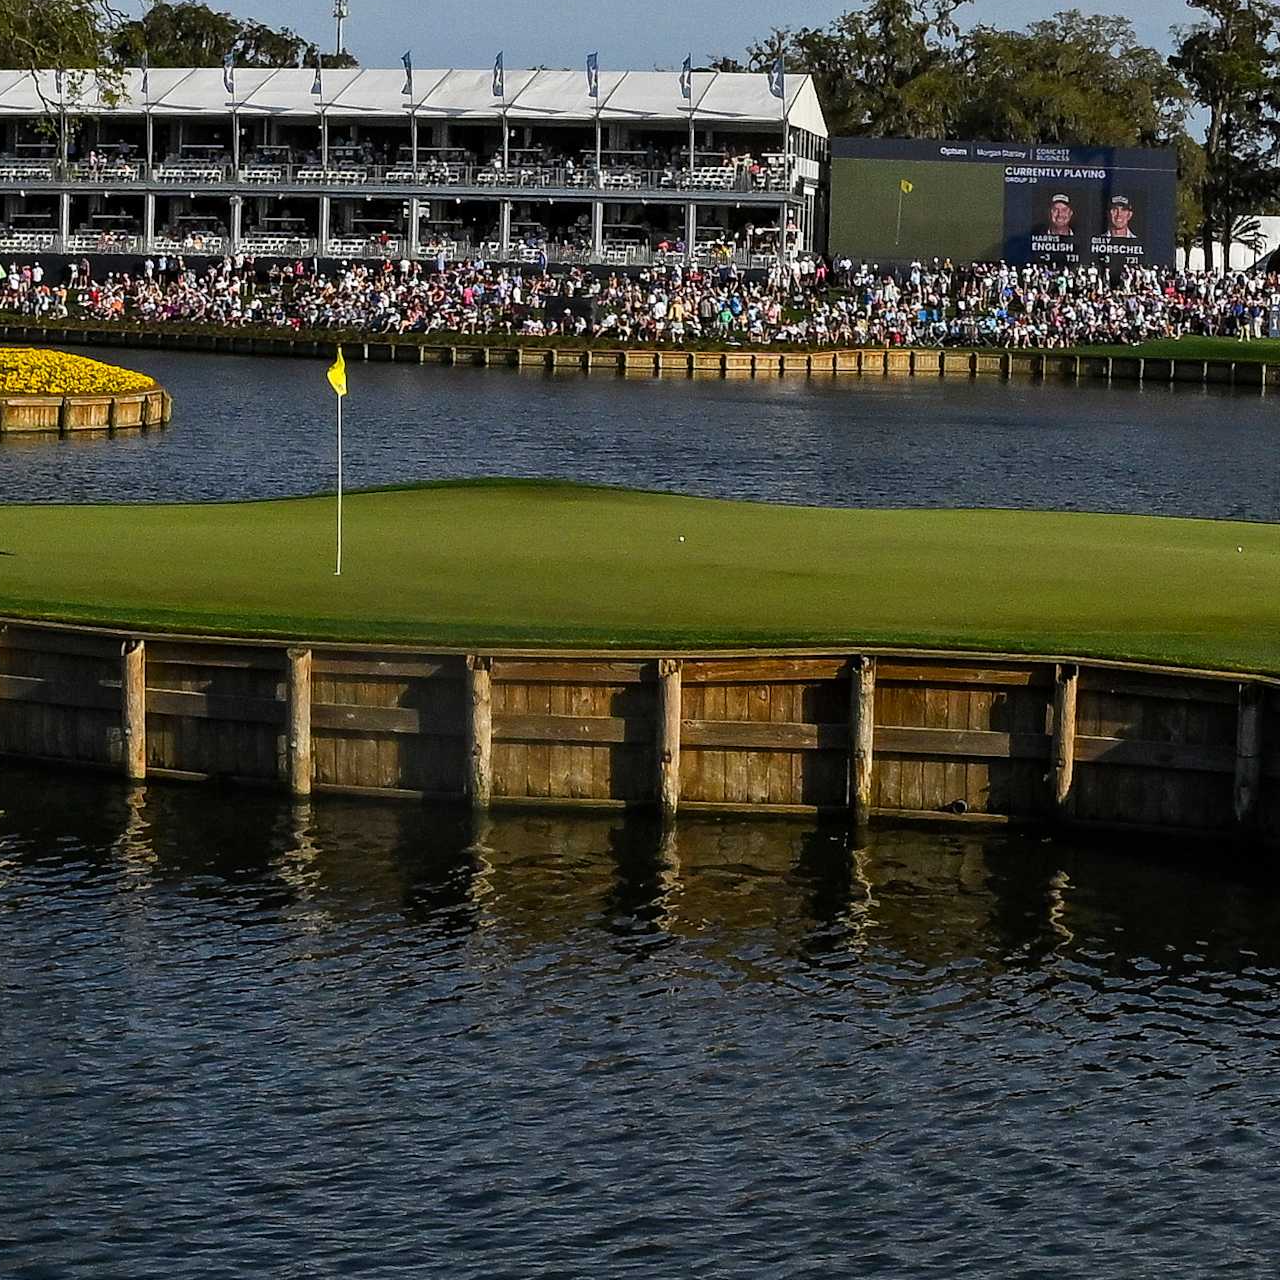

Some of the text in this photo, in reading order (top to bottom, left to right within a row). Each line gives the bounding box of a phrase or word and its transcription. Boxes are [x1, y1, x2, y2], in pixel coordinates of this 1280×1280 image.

[1005, 166, 1106, 180] CURRENTLY PLAYING
[1032, 242, 1074, 252] ENGLISH
[1091, 244, 1145, 255] HORSCHEL
